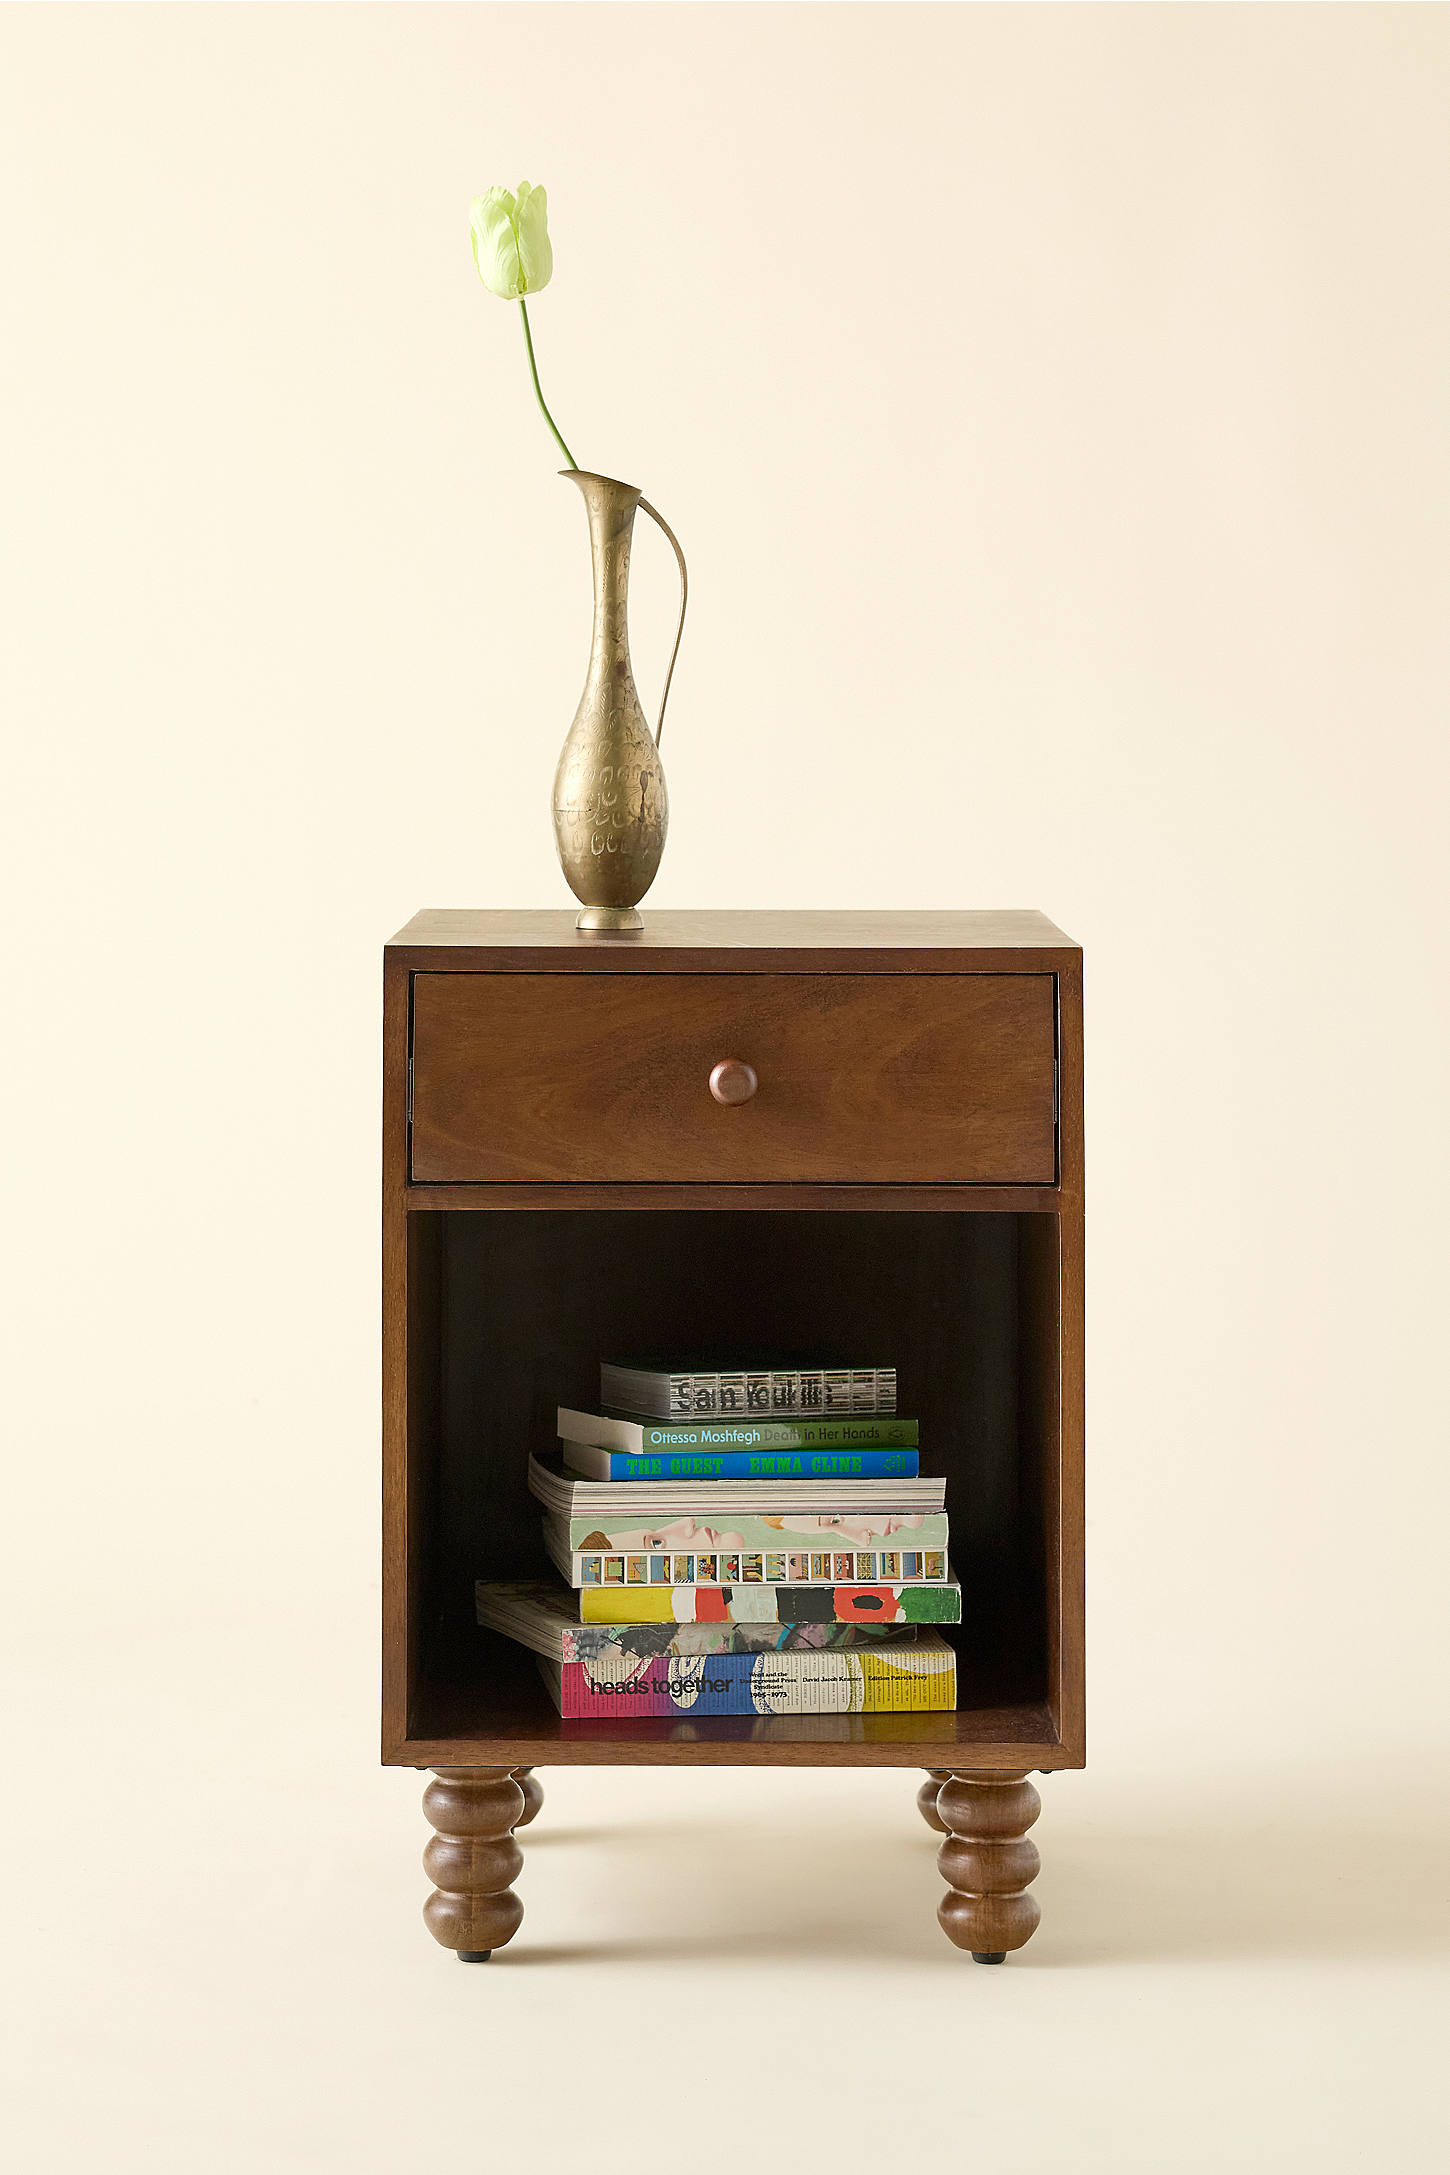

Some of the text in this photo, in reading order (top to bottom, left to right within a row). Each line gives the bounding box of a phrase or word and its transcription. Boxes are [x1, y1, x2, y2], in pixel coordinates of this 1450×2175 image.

[677, 1379, 736, 1410] Sam
[650, 1426, 880, 1445] Ottessa Moshfegh Death in Her Hands
[627, 1458, 661, 1475] THE
[670, 1457, 724, 1474] GUEST
[749, 1456, 803, 1473] EMMA
[811, 1456, 862, 1472] CLINE
[590, 1675, 734, 1698] heads together
[914, 1674, 928, 1682] Frey
